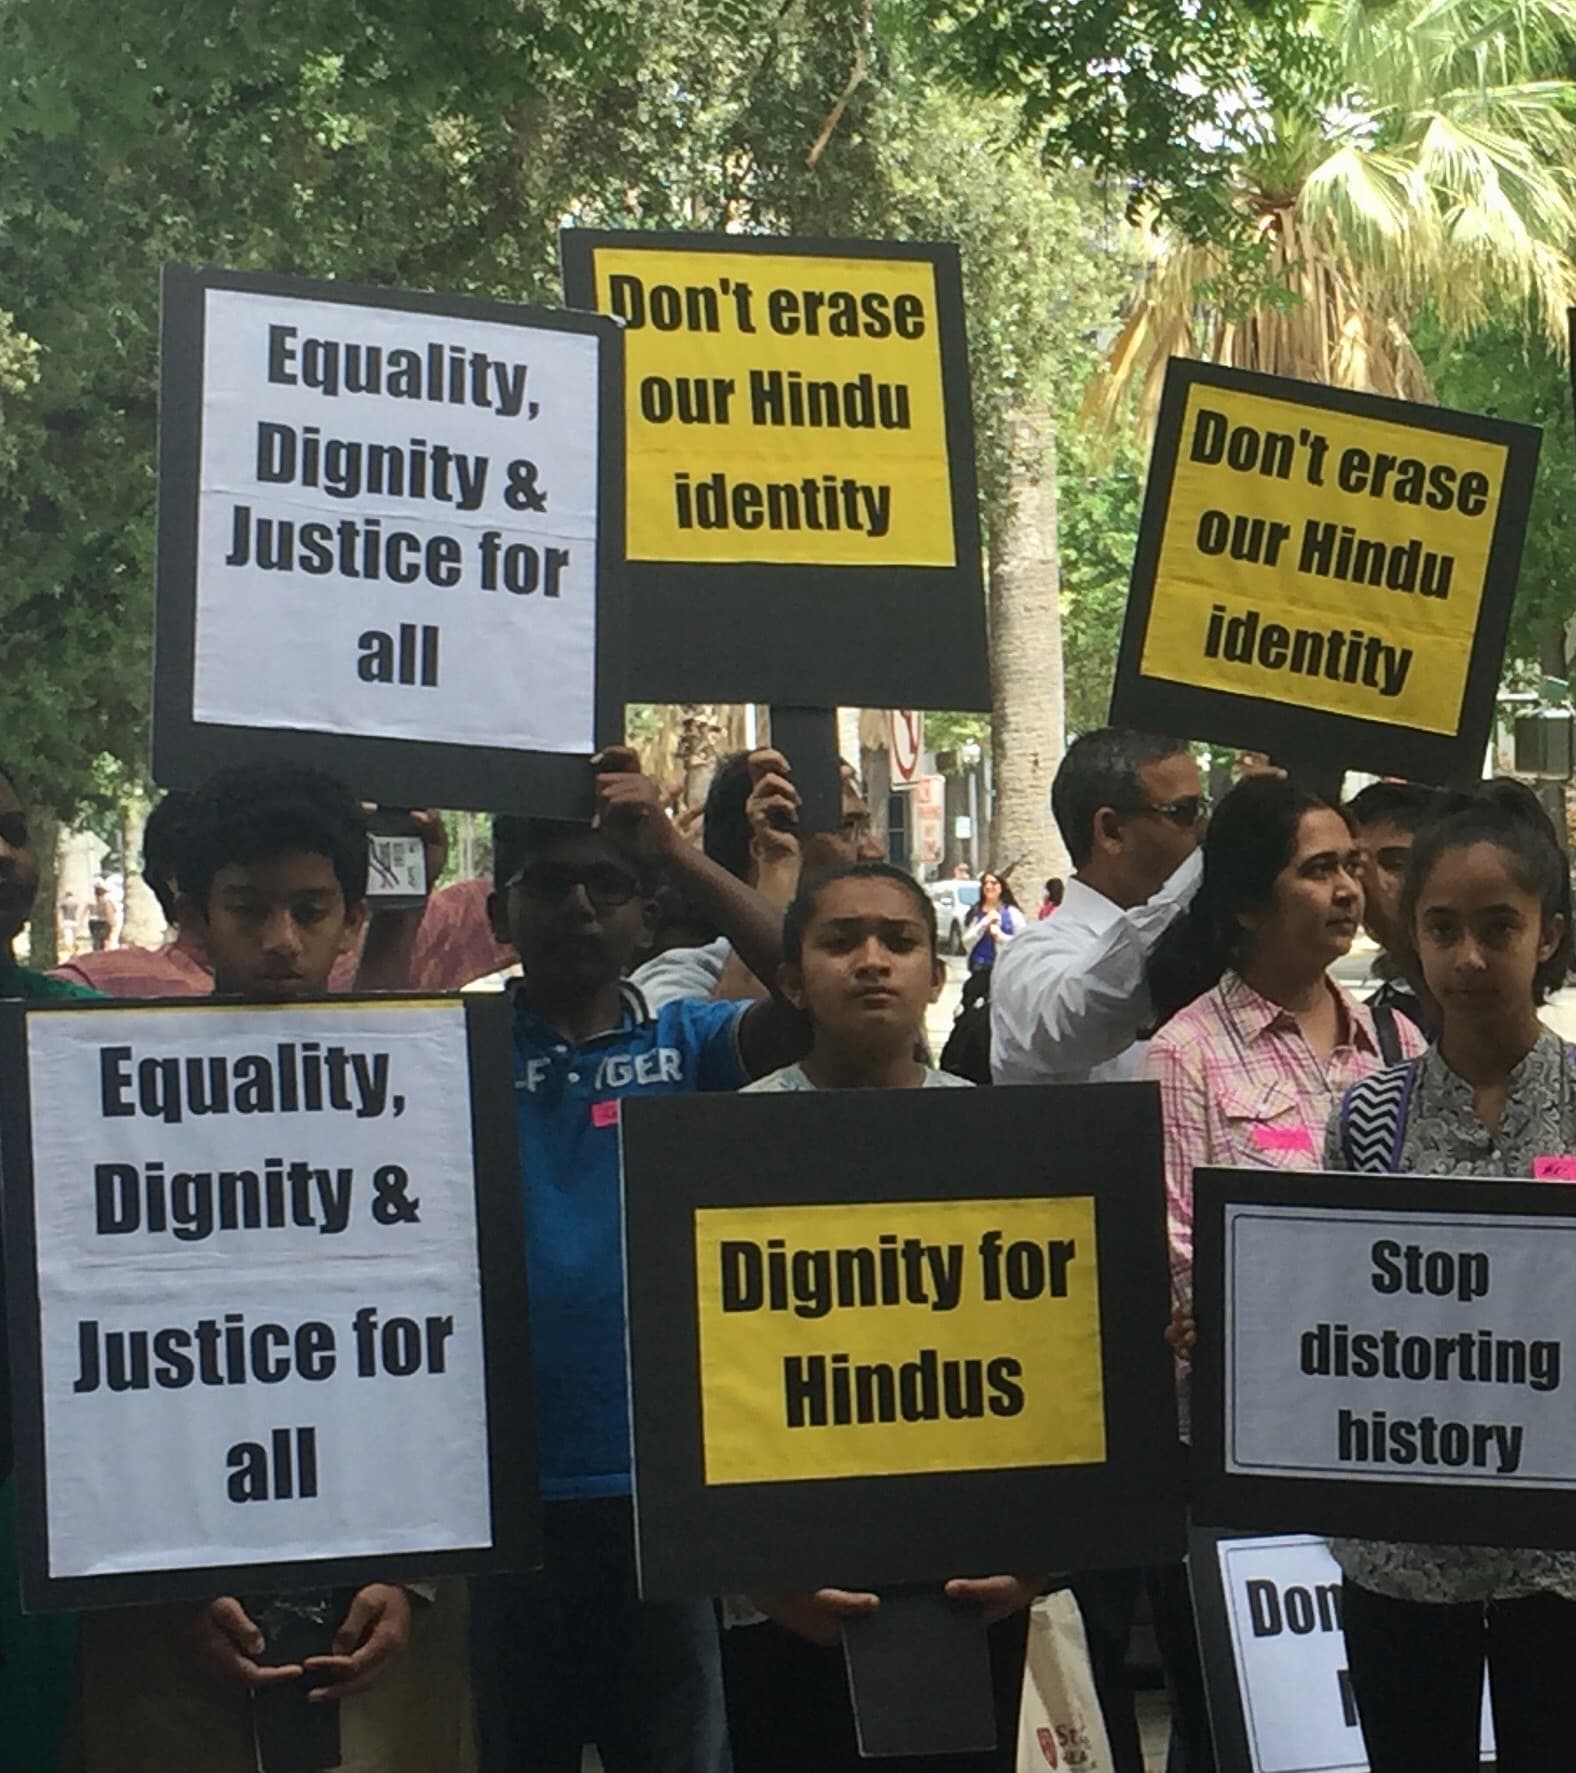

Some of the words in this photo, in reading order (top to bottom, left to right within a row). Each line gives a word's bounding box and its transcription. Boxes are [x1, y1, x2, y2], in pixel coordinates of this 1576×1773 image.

[609, 274, 756, 334] Don't
[768, 288, 925, 340] erase
[267, 324, 539, 420] Equality,
[640, 375, 735, 425] our
[750, 370, 911, 430] Hindu
[257, 422, 488, 510] Dignity
[503, 459, 548, 513] &
[1190, 408, 1329, 487] Don't
[1339, 447, 1490, 517] erase
[675, 472, 890, 537] identity
[226, 506, 462, 588] Justice
[479, 531, 569, 598] for
[1197, 510, 1291, 567] our
[1298, 518, 1455, 600] Hindu
[357, 624, 439, 686] all
[1204, 604, 1414, 697] identity
[100, 1042, 406, 1124] Equality,
[94, 1158, 353, 1241] Dignity
[371, 1163, 421, 1225] &
[720, 1235, 964, 1319] Dignity
[978, 1231, 1076, 1301] for
[1371, 1239, 1490, 1302] Stop
[73, 1313, 336, 1393] Justice
[352, 1307, 454, 1378] for
[783, 1349, 1026, 1429] Hindus
[1300, 1323, 1561, 1392] distorting
[225, 1427, 318, 1504] all
[1338, 1408, 1524, 1474] history
[1246, 1578, 1343, 1638] Don
